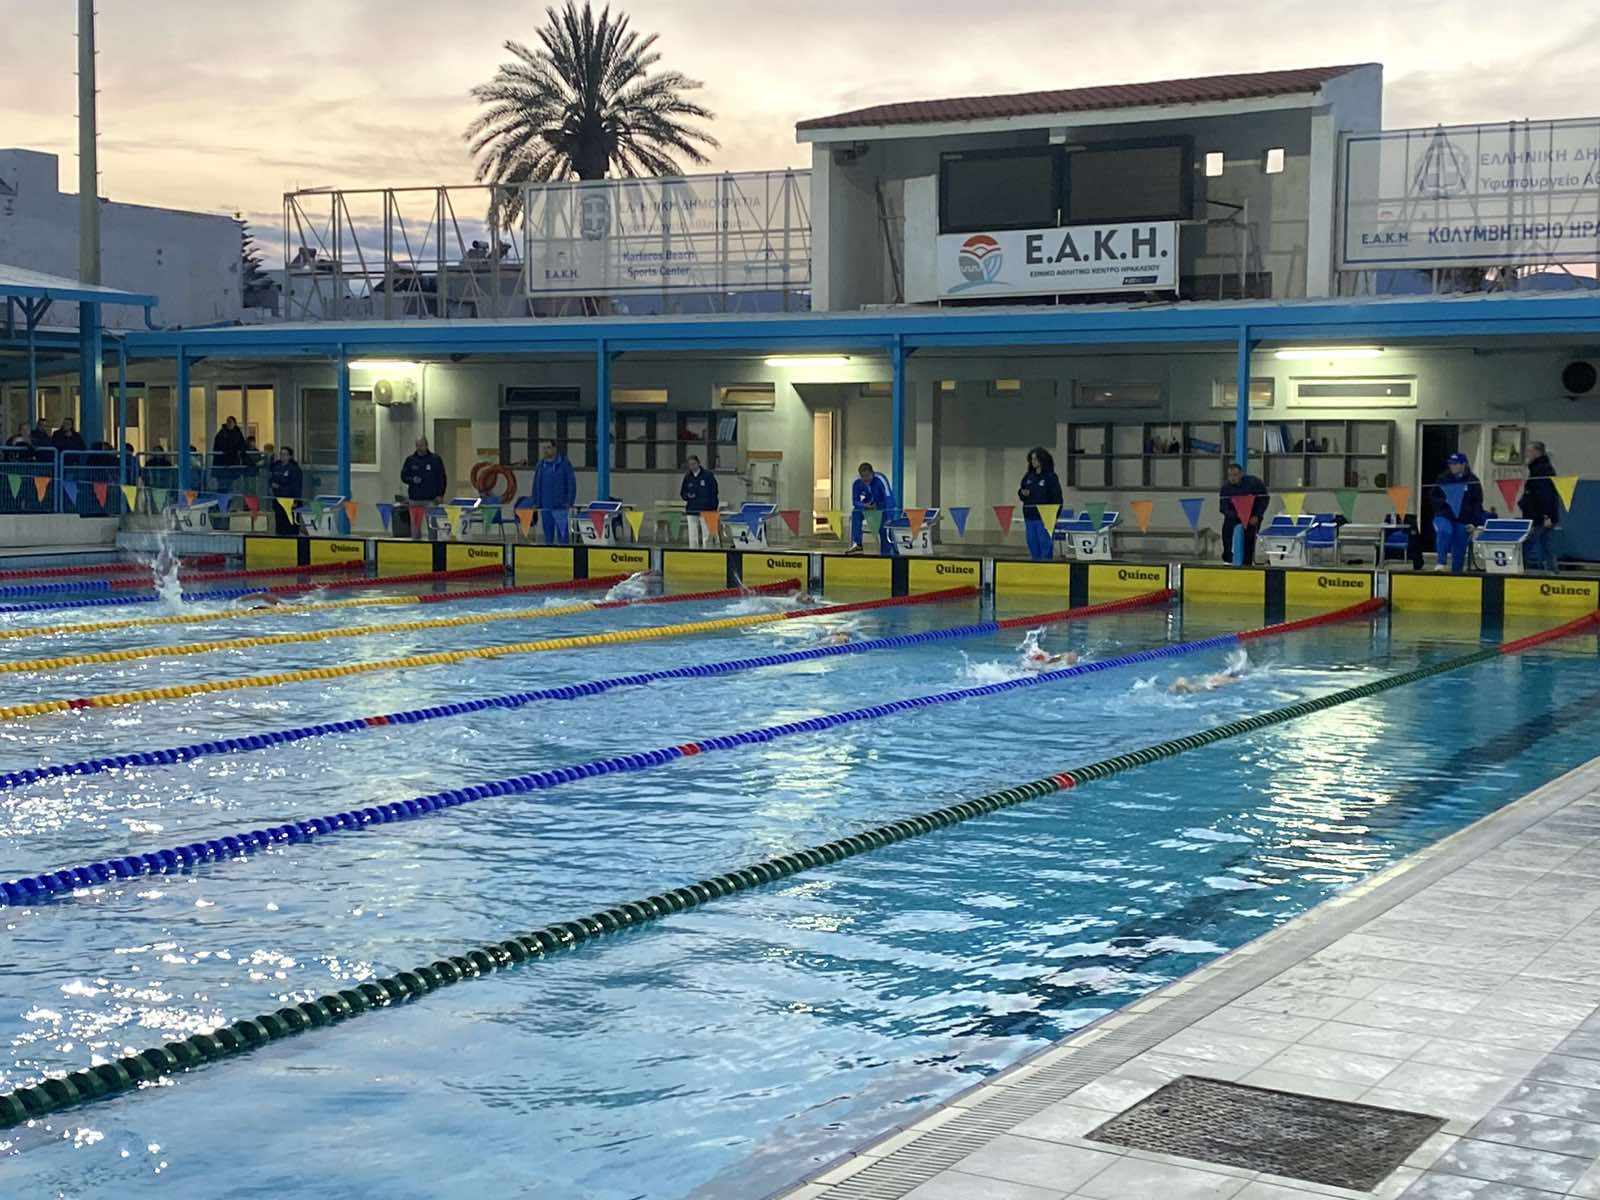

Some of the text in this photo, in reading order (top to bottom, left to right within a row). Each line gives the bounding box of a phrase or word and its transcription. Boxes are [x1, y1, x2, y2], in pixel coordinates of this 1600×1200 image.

[1574, 147, 1600, 161] ΔΗ
[1428, 221, 1564, 244] ΚΟΛΥΜΒΗΤΗΡΙΟ
[1025, 227, 1168, 265] Ε.Α.Κ.Η.
[330, 543, 360, 553] Quince
[467, 548, 499, 558] Quince
[610, 553, 644, 563] Quince
[766, 558, 803, 568] Quince
[935, 563, 975, 574] Quince
[1117, 569, 1160, 581] Quince
[1317, 576, 1364, 587] Quince
[1540, 583, 1591, 596] Quince
